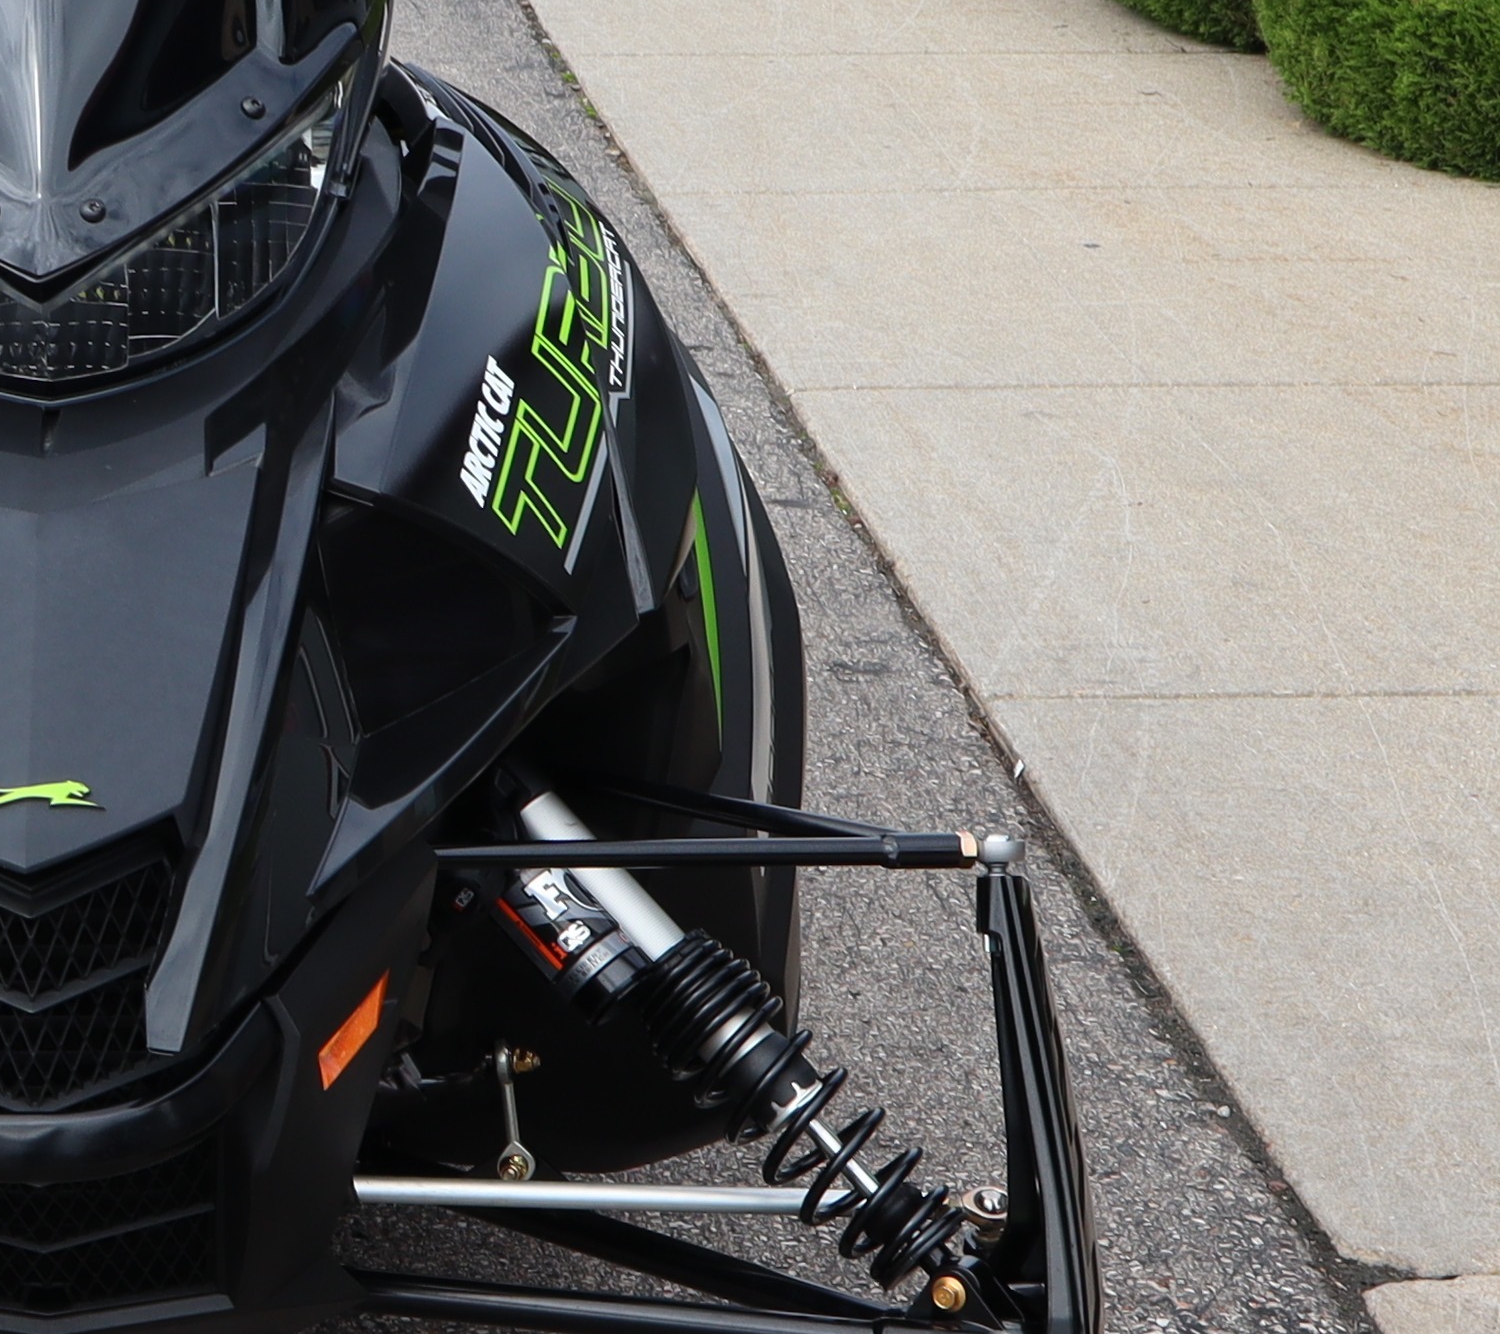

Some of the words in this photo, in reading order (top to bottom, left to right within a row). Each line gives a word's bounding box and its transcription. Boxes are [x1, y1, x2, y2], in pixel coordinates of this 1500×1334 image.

[598, 220, 624, 387] THUNDERCAT
[480, 353, 517, 418] CAT
[459, 398, 507, 509] ARCTIC
